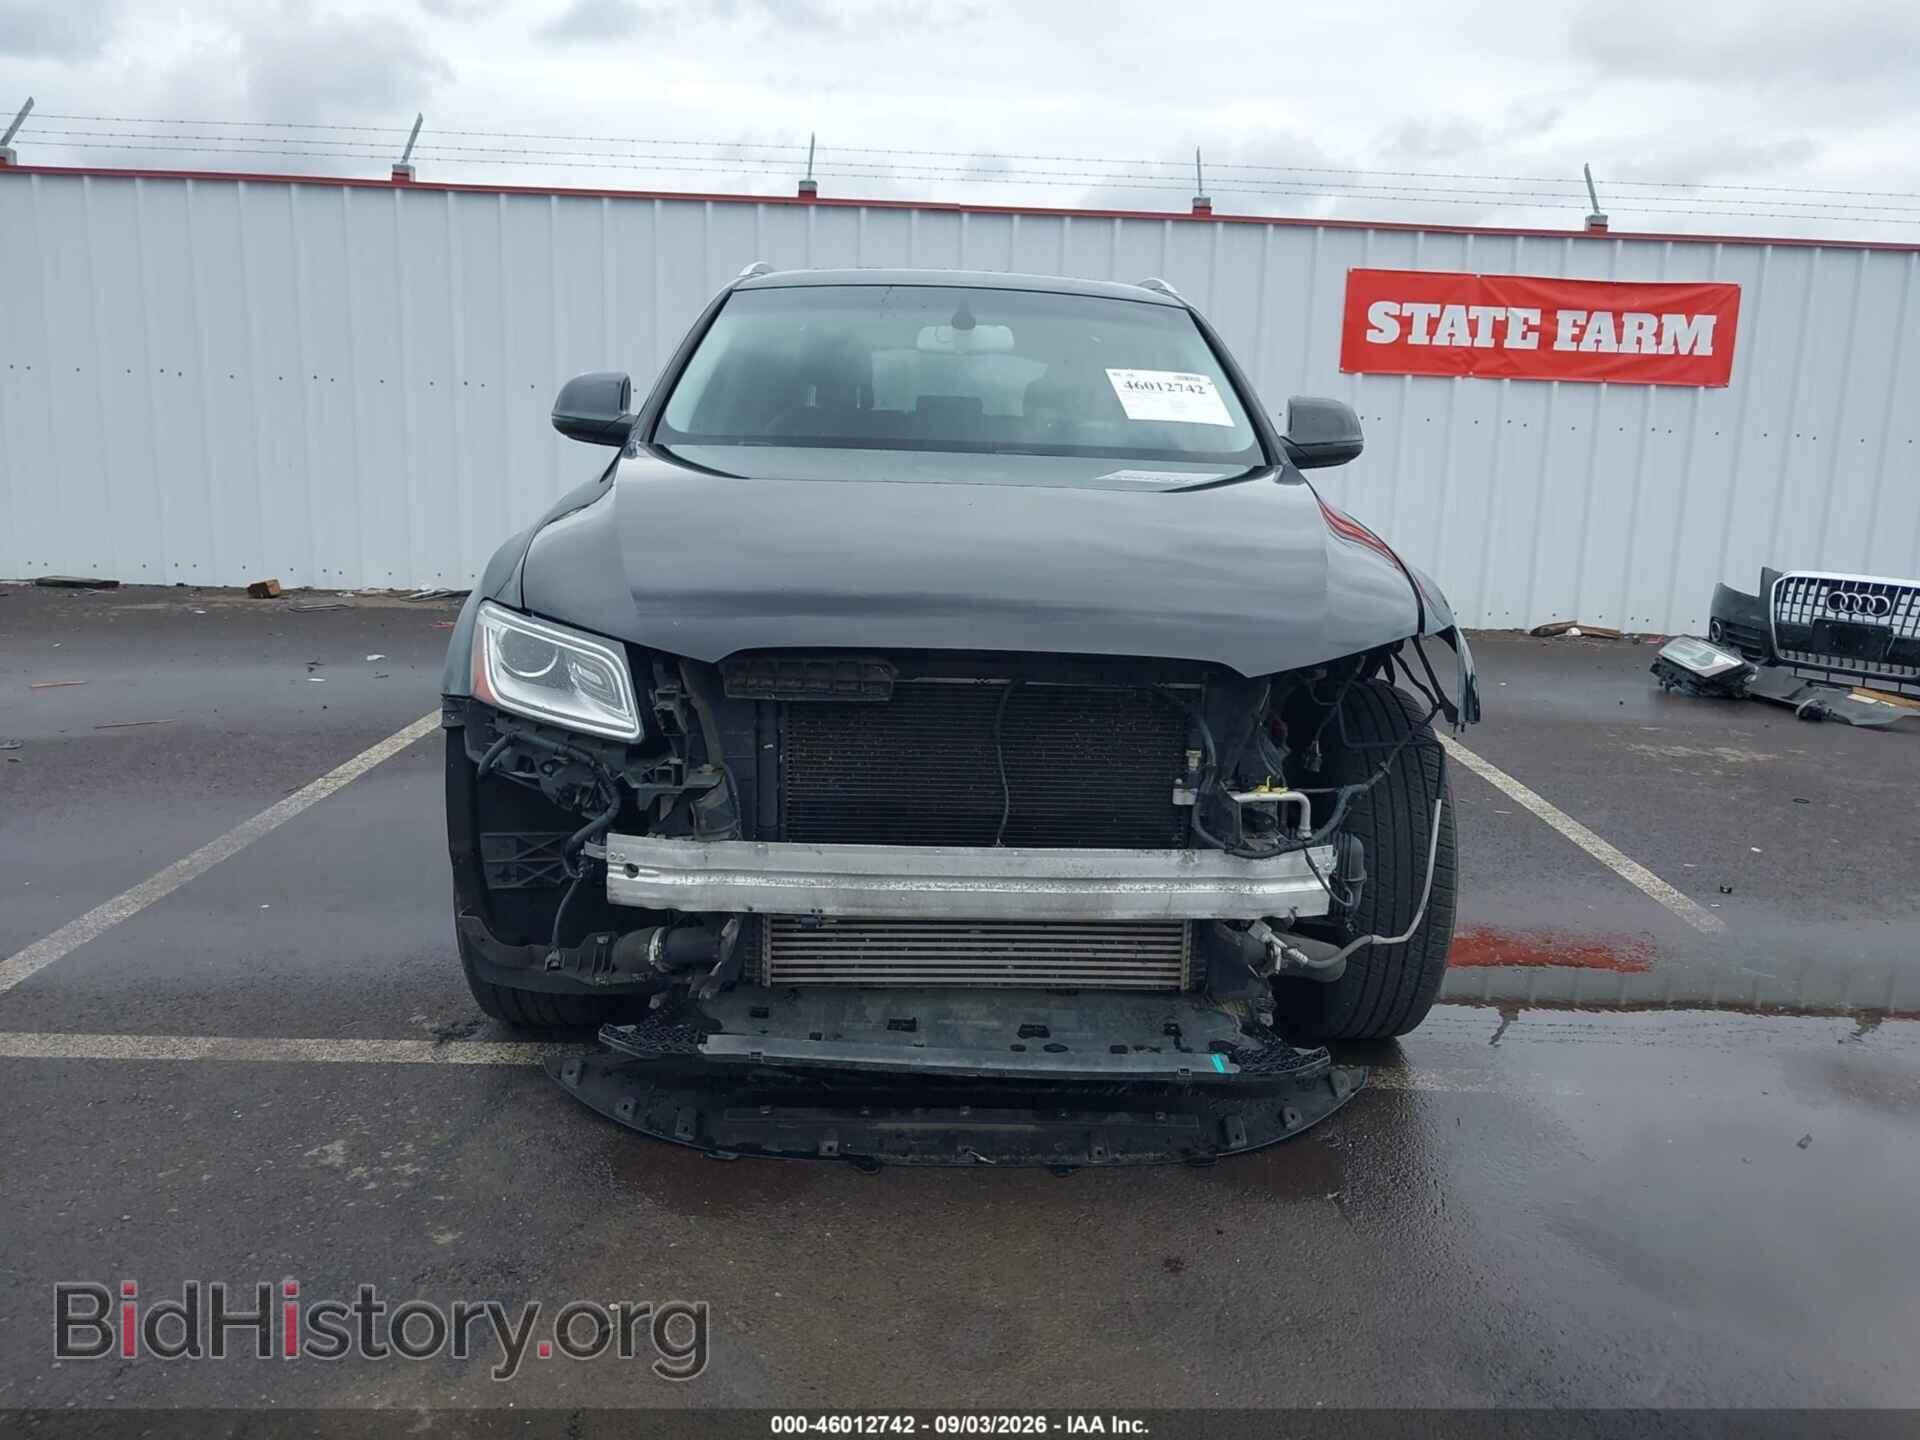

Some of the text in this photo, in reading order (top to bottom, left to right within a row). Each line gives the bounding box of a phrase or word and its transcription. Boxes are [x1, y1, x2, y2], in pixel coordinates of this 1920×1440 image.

[1366, 301, 1718, 356] STATE FARM
[1123, 380, 1207, 395] 46012742
